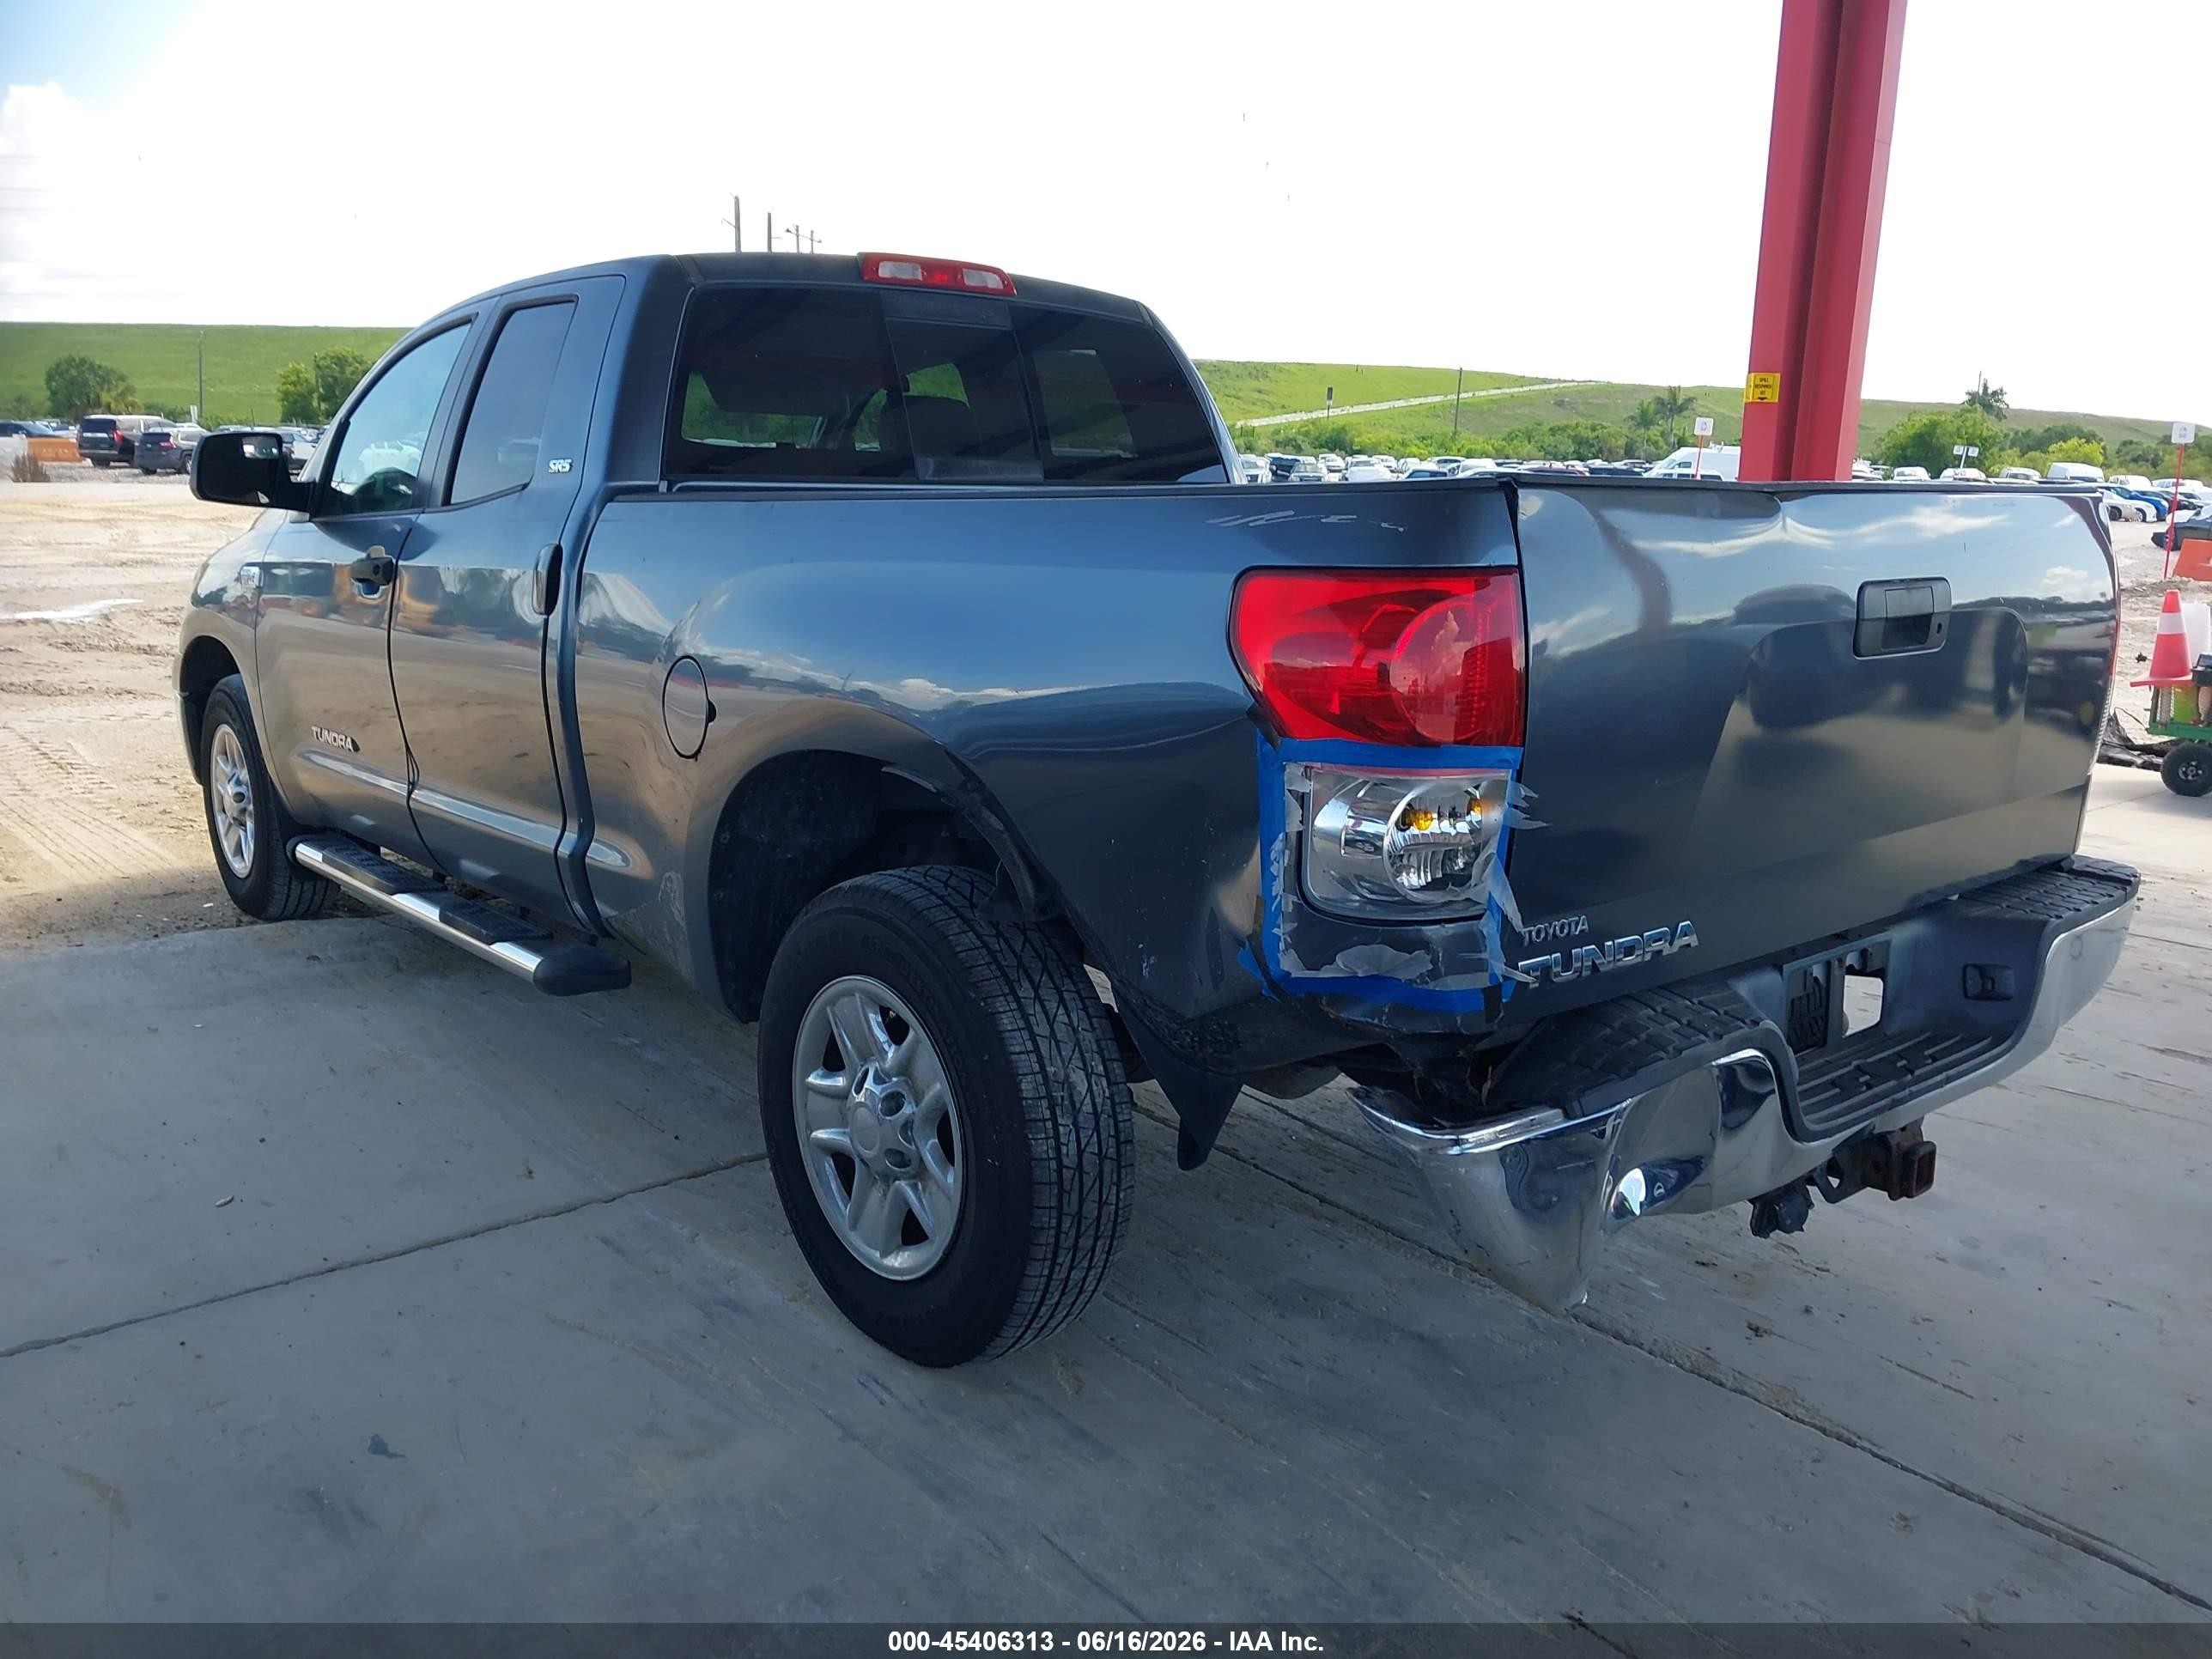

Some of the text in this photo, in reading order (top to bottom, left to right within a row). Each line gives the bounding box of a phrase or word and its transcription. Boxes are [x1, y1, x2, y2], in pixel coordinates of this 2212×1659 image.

[549, 459, 572, 473] SR5
[311, 726, 354, 753] TUNDRA
[1522, 915, 1589, 946] TOYOTA
[1518, 921, 1699, 989] TUNDRA
